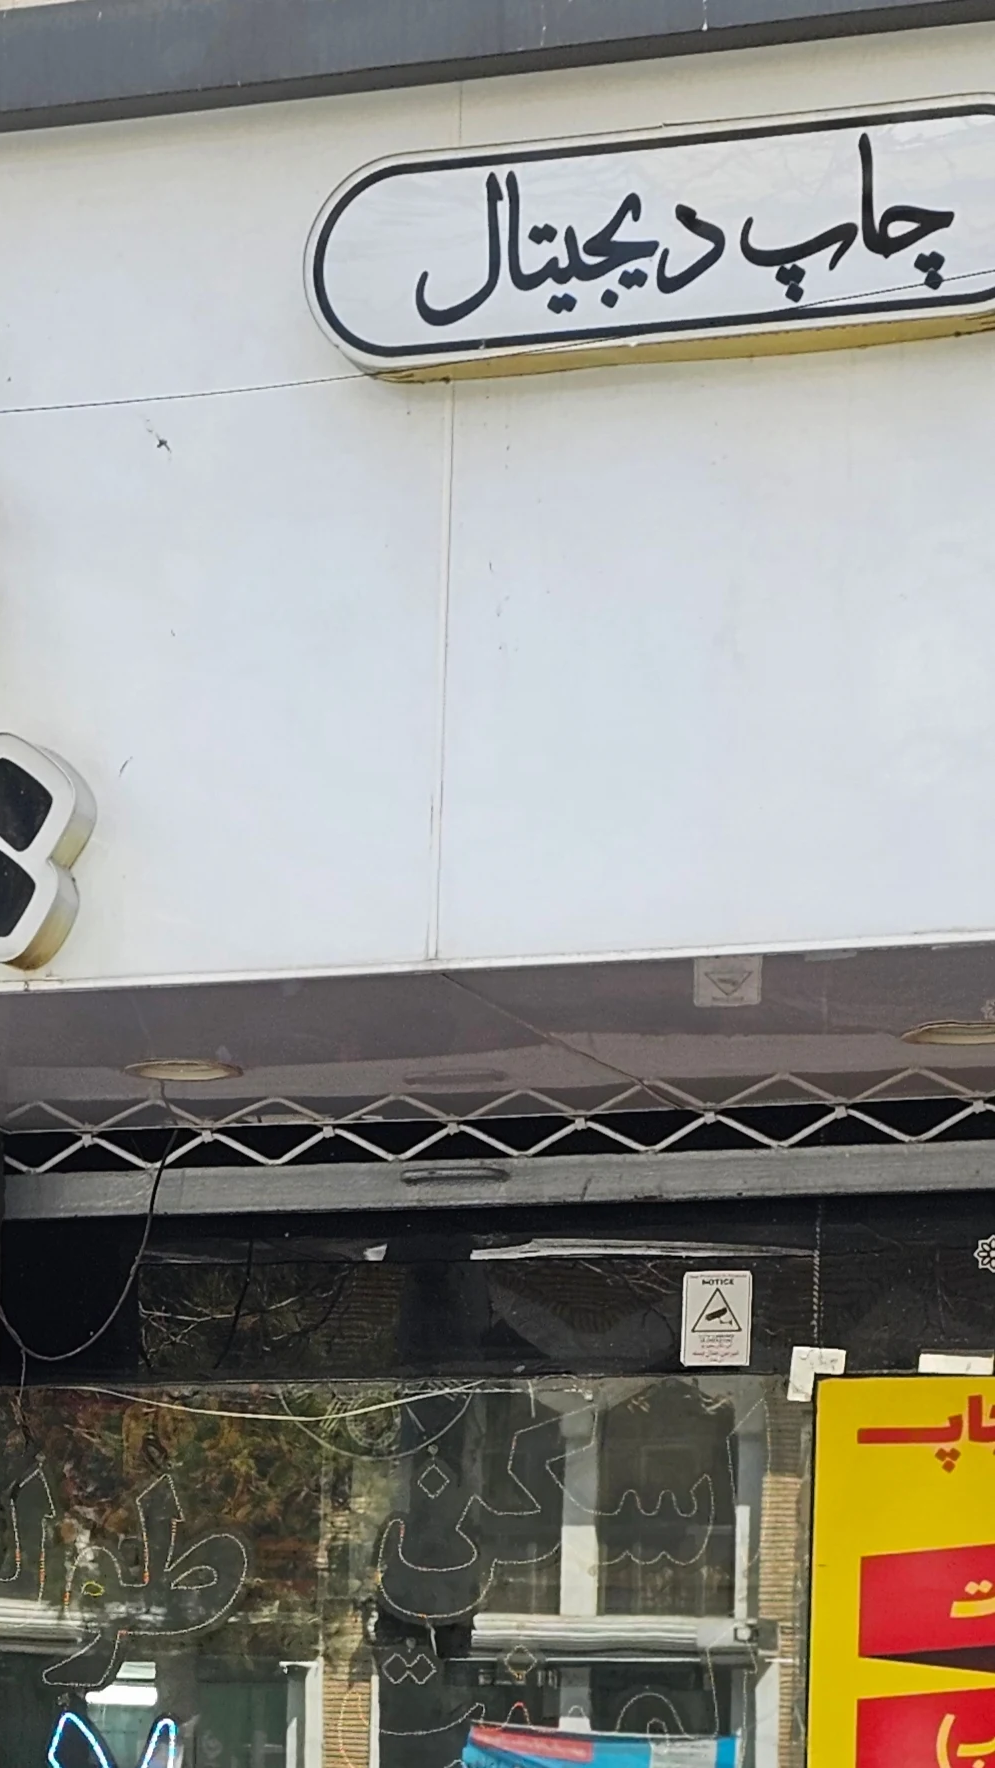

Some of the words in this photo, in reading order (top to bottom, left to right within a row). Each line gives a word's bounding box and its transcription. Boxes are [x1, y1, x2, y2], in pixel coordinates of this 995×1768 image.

[415, 170, 725, 328] دیجیتال
[740, 132, 955, 302] چاپ
[378, 1397, 771, 1619] اسکن
